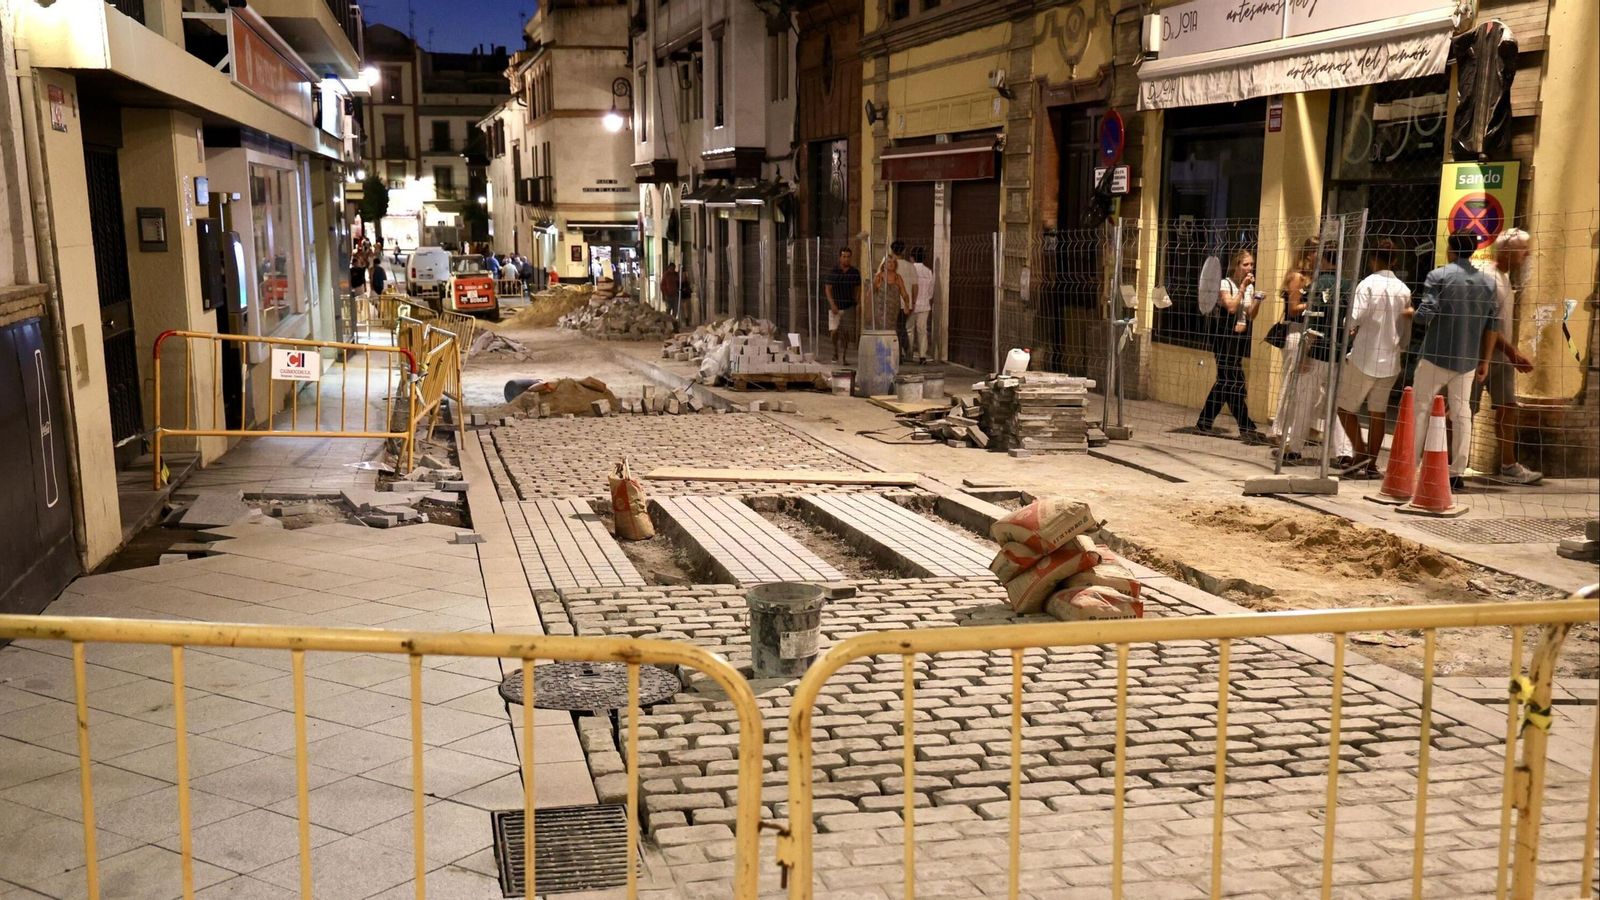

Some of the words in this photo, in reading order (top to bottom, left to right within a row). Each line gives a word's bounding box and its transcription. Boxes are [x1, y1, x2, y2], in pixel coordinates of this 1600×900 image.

[1286, 57, 1353, 80] artesanos
[1357, 46, 1382, 75] del
[1458, 169, 1501, 185] sando
